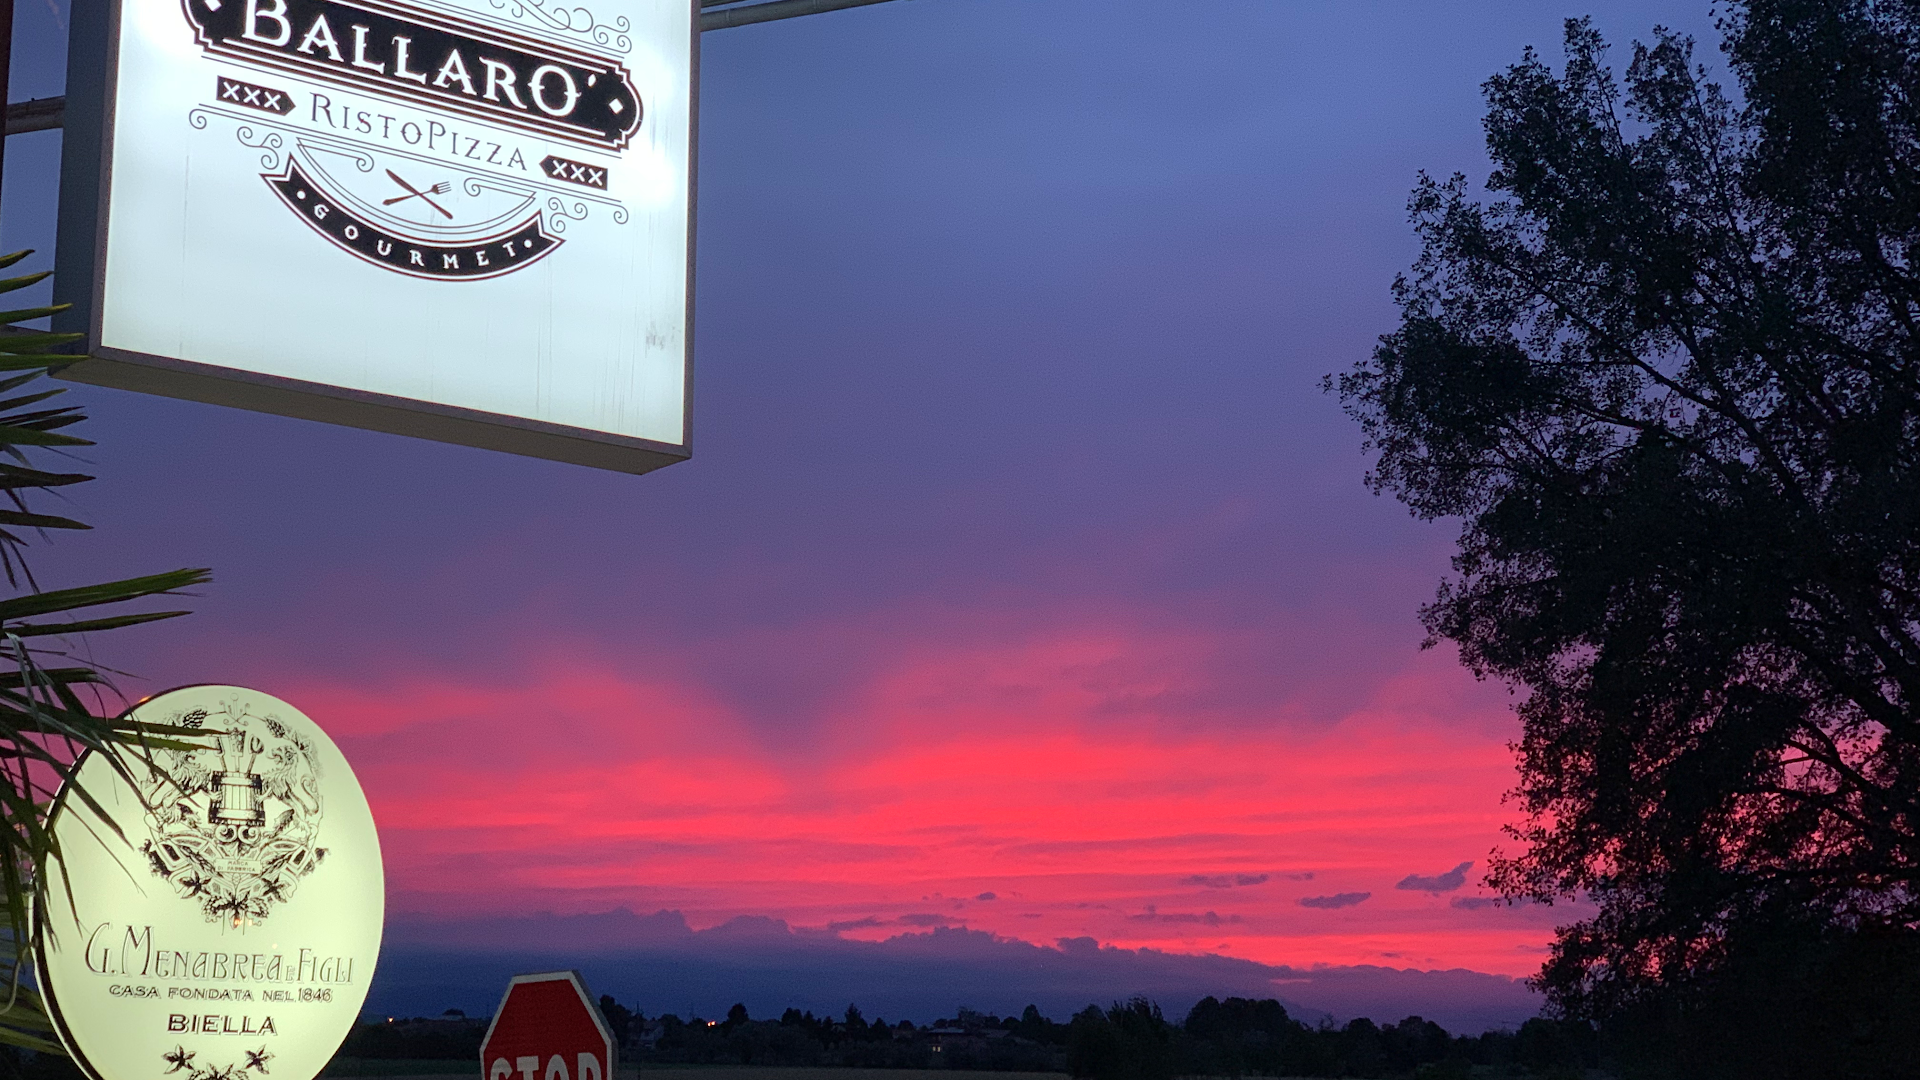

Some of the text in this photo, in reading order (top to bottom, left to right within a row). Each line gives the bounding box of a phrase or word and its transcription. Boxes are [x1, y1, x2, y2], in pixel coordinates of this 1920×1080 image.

[313, 203, 518, 270] GOURMET
[121, 925, 283, 982] MENABREA
[297, 947, 354, 985] FIGLI
[109, 984, 334, 1003] CASA FONDATA NEL 1846
[167, 1013, 278, 1036] BIELLA
